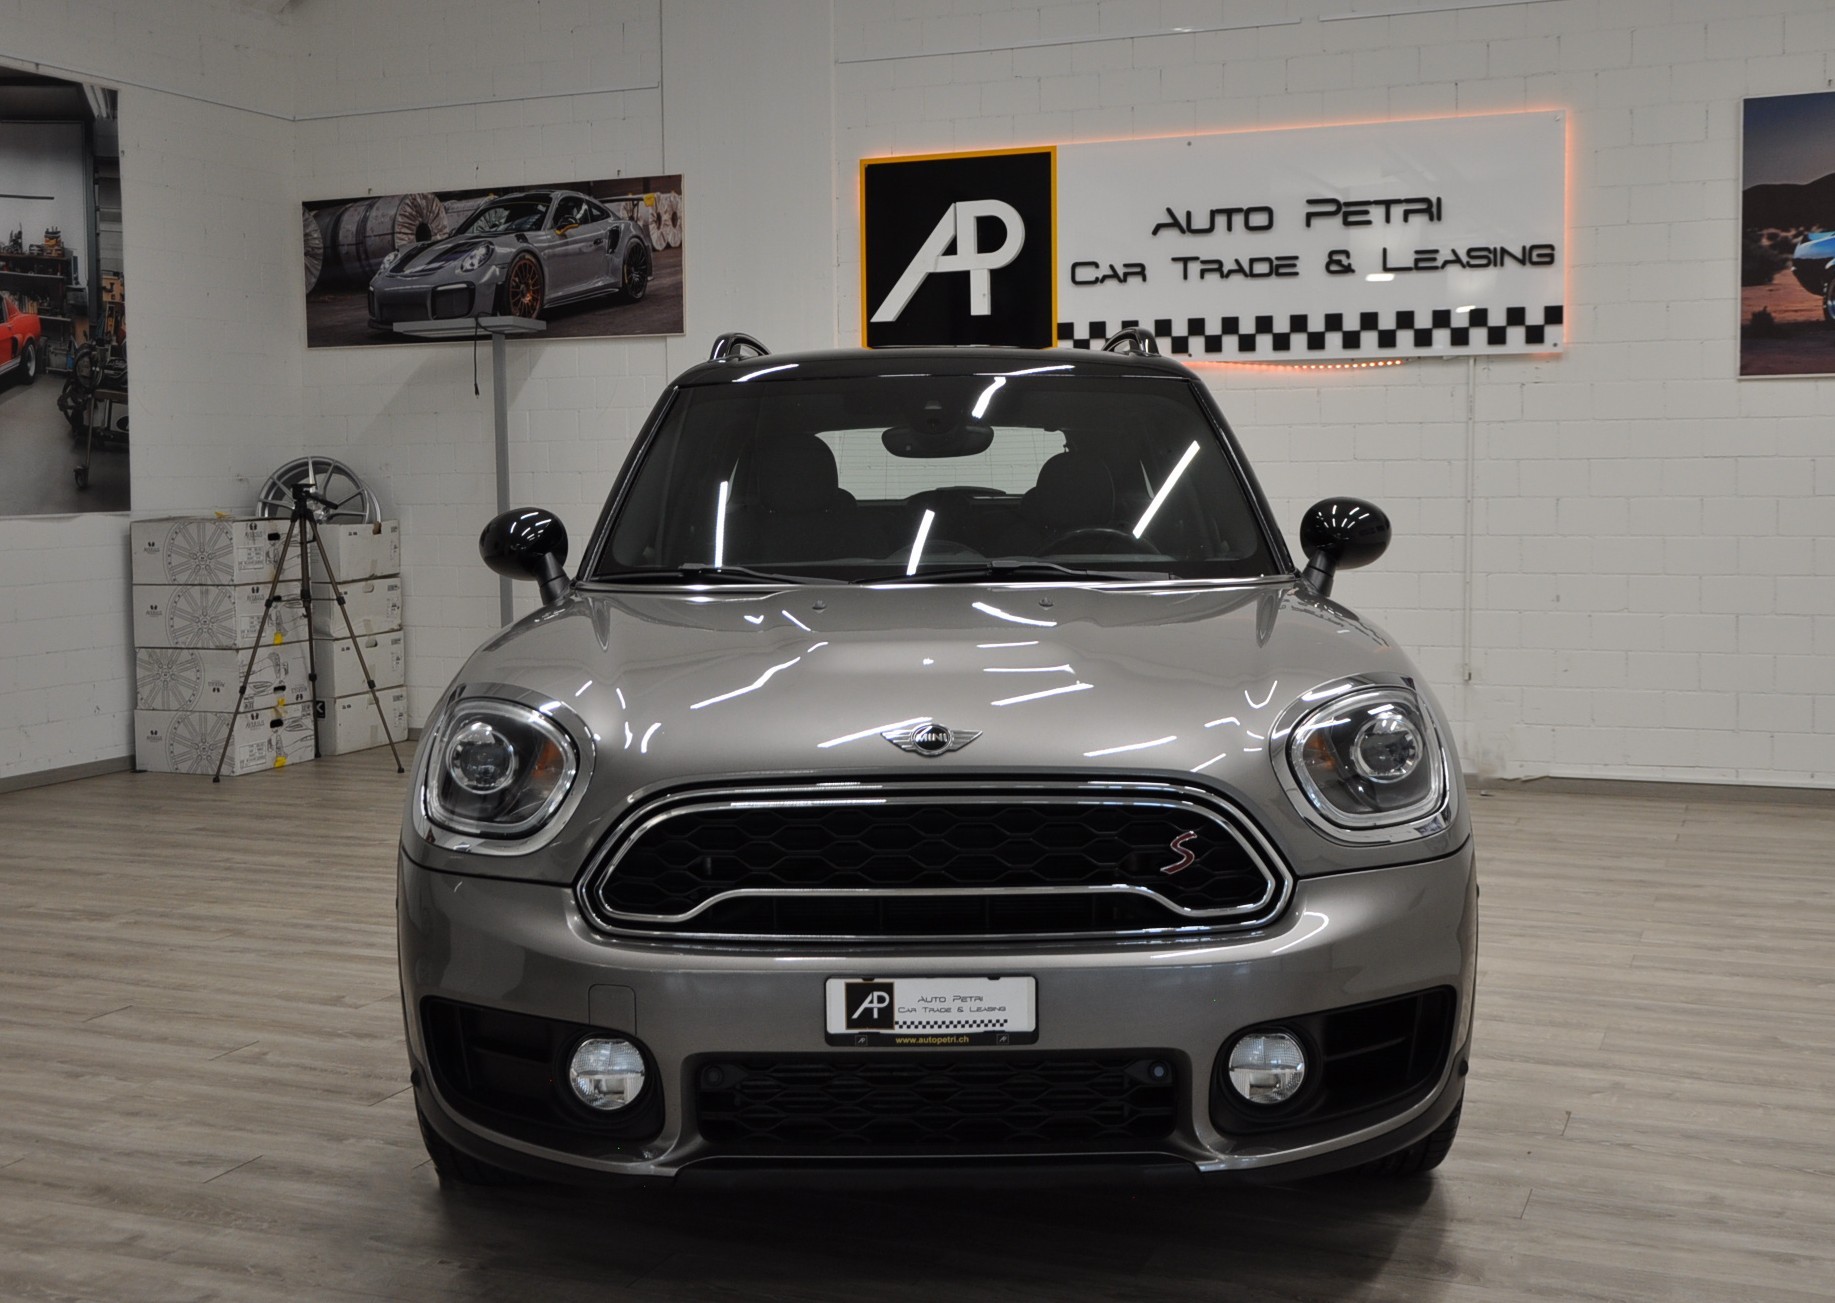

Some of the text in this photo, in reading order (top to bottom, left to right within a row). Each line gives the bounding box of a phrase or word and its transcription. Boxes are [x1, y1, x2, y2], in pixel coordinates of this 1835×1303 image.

[1152, 196, 1443, 236] AUTO PETRI
[871, 198, 1026, 323] AP
[1071, 243, 1556, 286] CAR TRADE & LEASING
[915, 732, 948, 743] MINI
[1160, 830, 1198, 875] S
[851, 991, 890, 1019] AP
[917, 995, 983, 1003] AUTO PETRI
[895, 1036, 969, 1045] www.autopetri.ch
